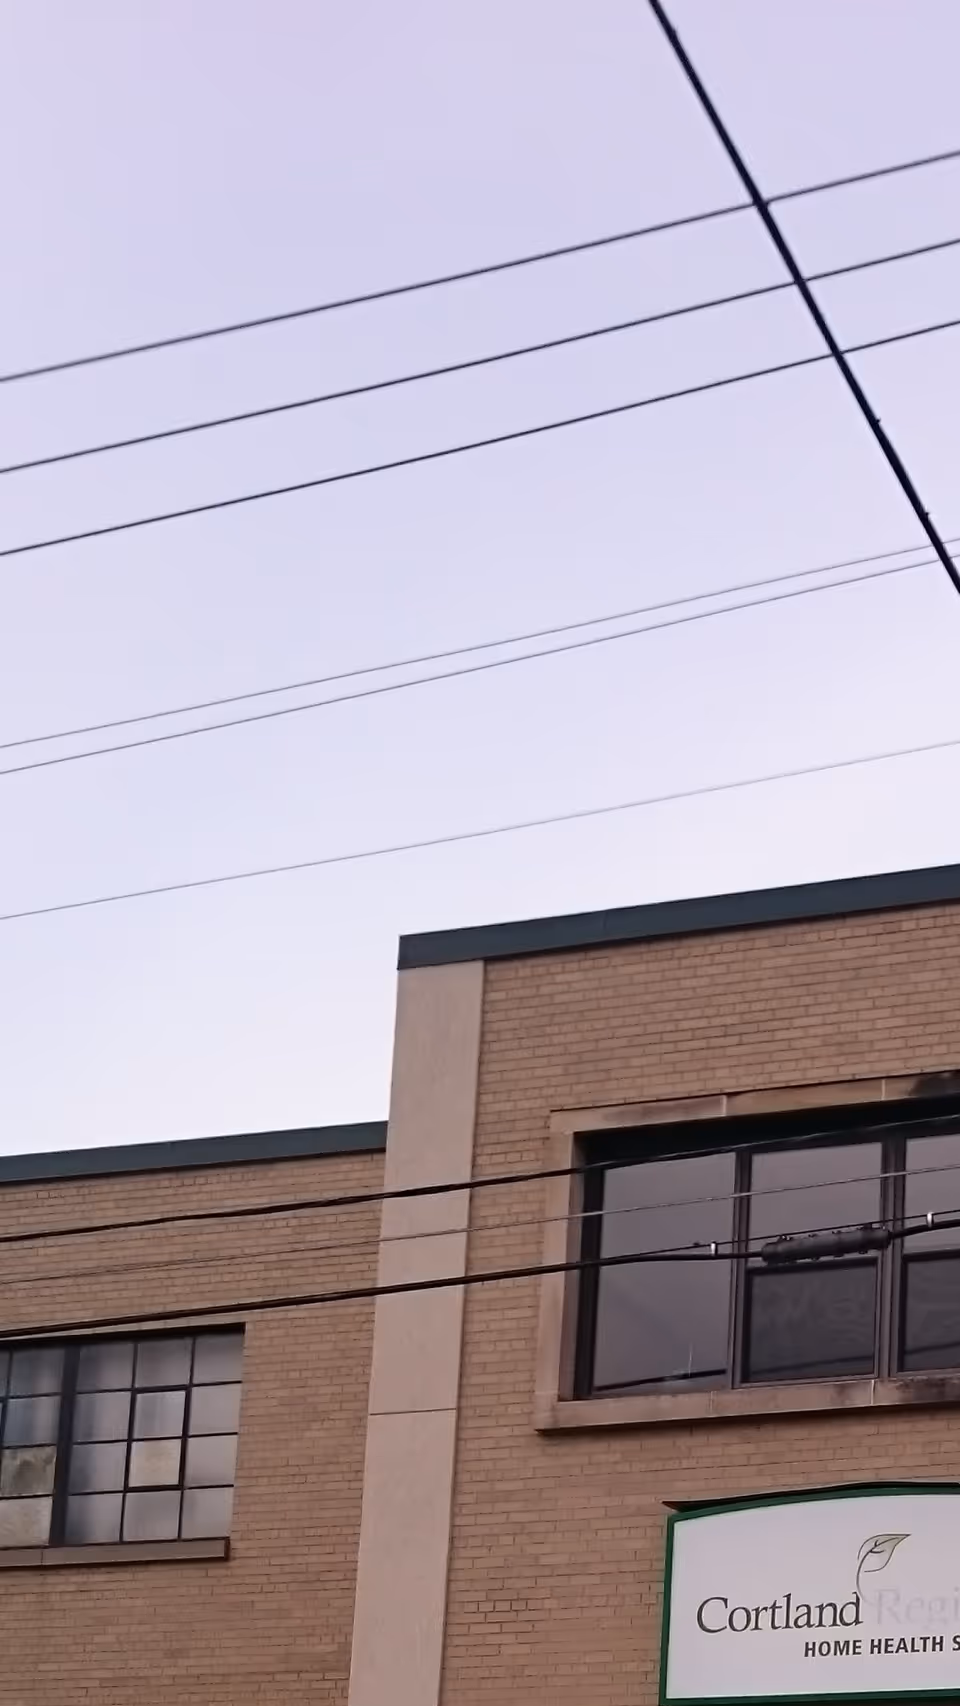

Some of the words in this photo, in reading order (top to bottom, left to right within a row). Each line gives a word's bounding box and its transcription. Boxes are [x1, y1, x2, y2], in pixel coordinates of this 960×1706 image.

[696, 1591, 864, 1634] Cortland
[803, 1640, 863, 1658] HOME
[869, 1635, 944, 1655] HEALTH
